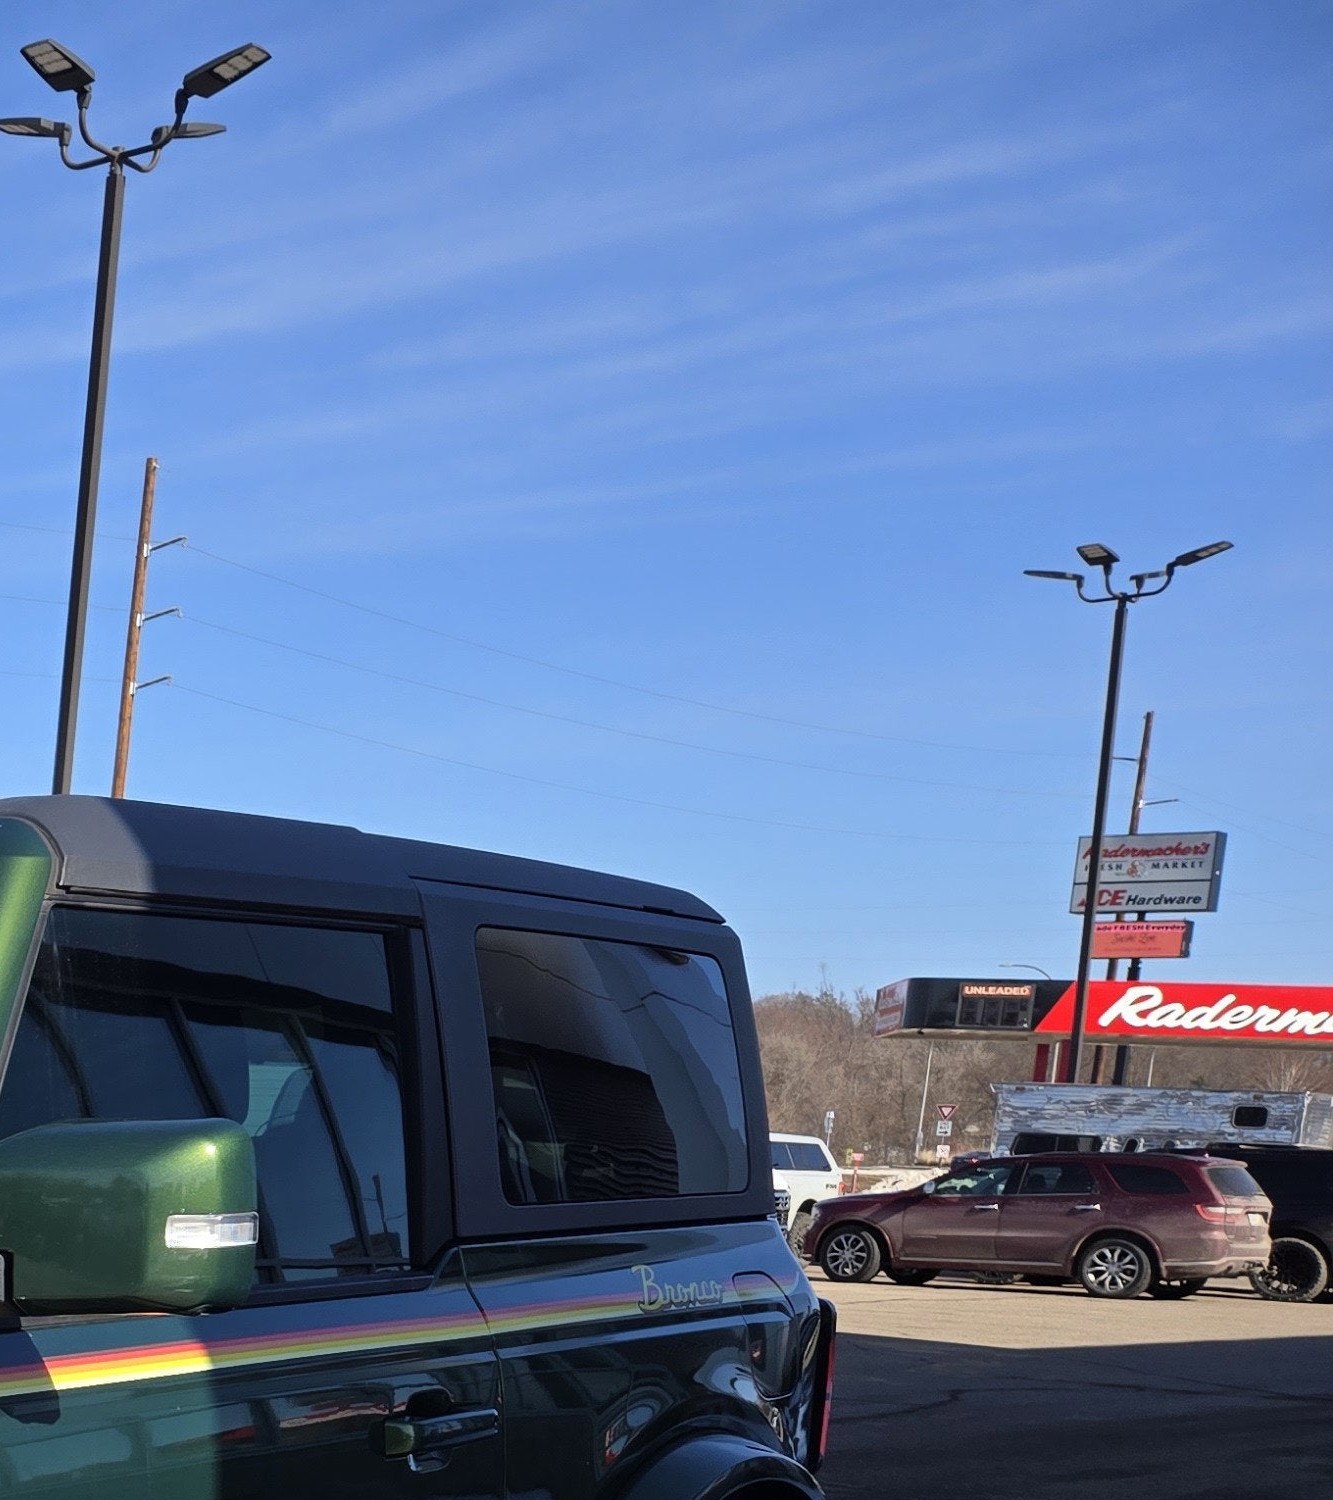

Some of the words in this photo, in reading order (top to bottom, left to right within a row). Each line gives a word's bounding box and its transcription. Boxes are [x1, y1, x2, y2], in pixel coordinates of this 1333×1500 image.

[1151, 861, 1204, 870] MARKET
[1125, 894, 1202, 906] Hardware
[964, 985, 1030, 996] UNLEADED
[1098, 985, 1333, 1036] Raderm
[631, 1265, 723, 1311] Bronco
